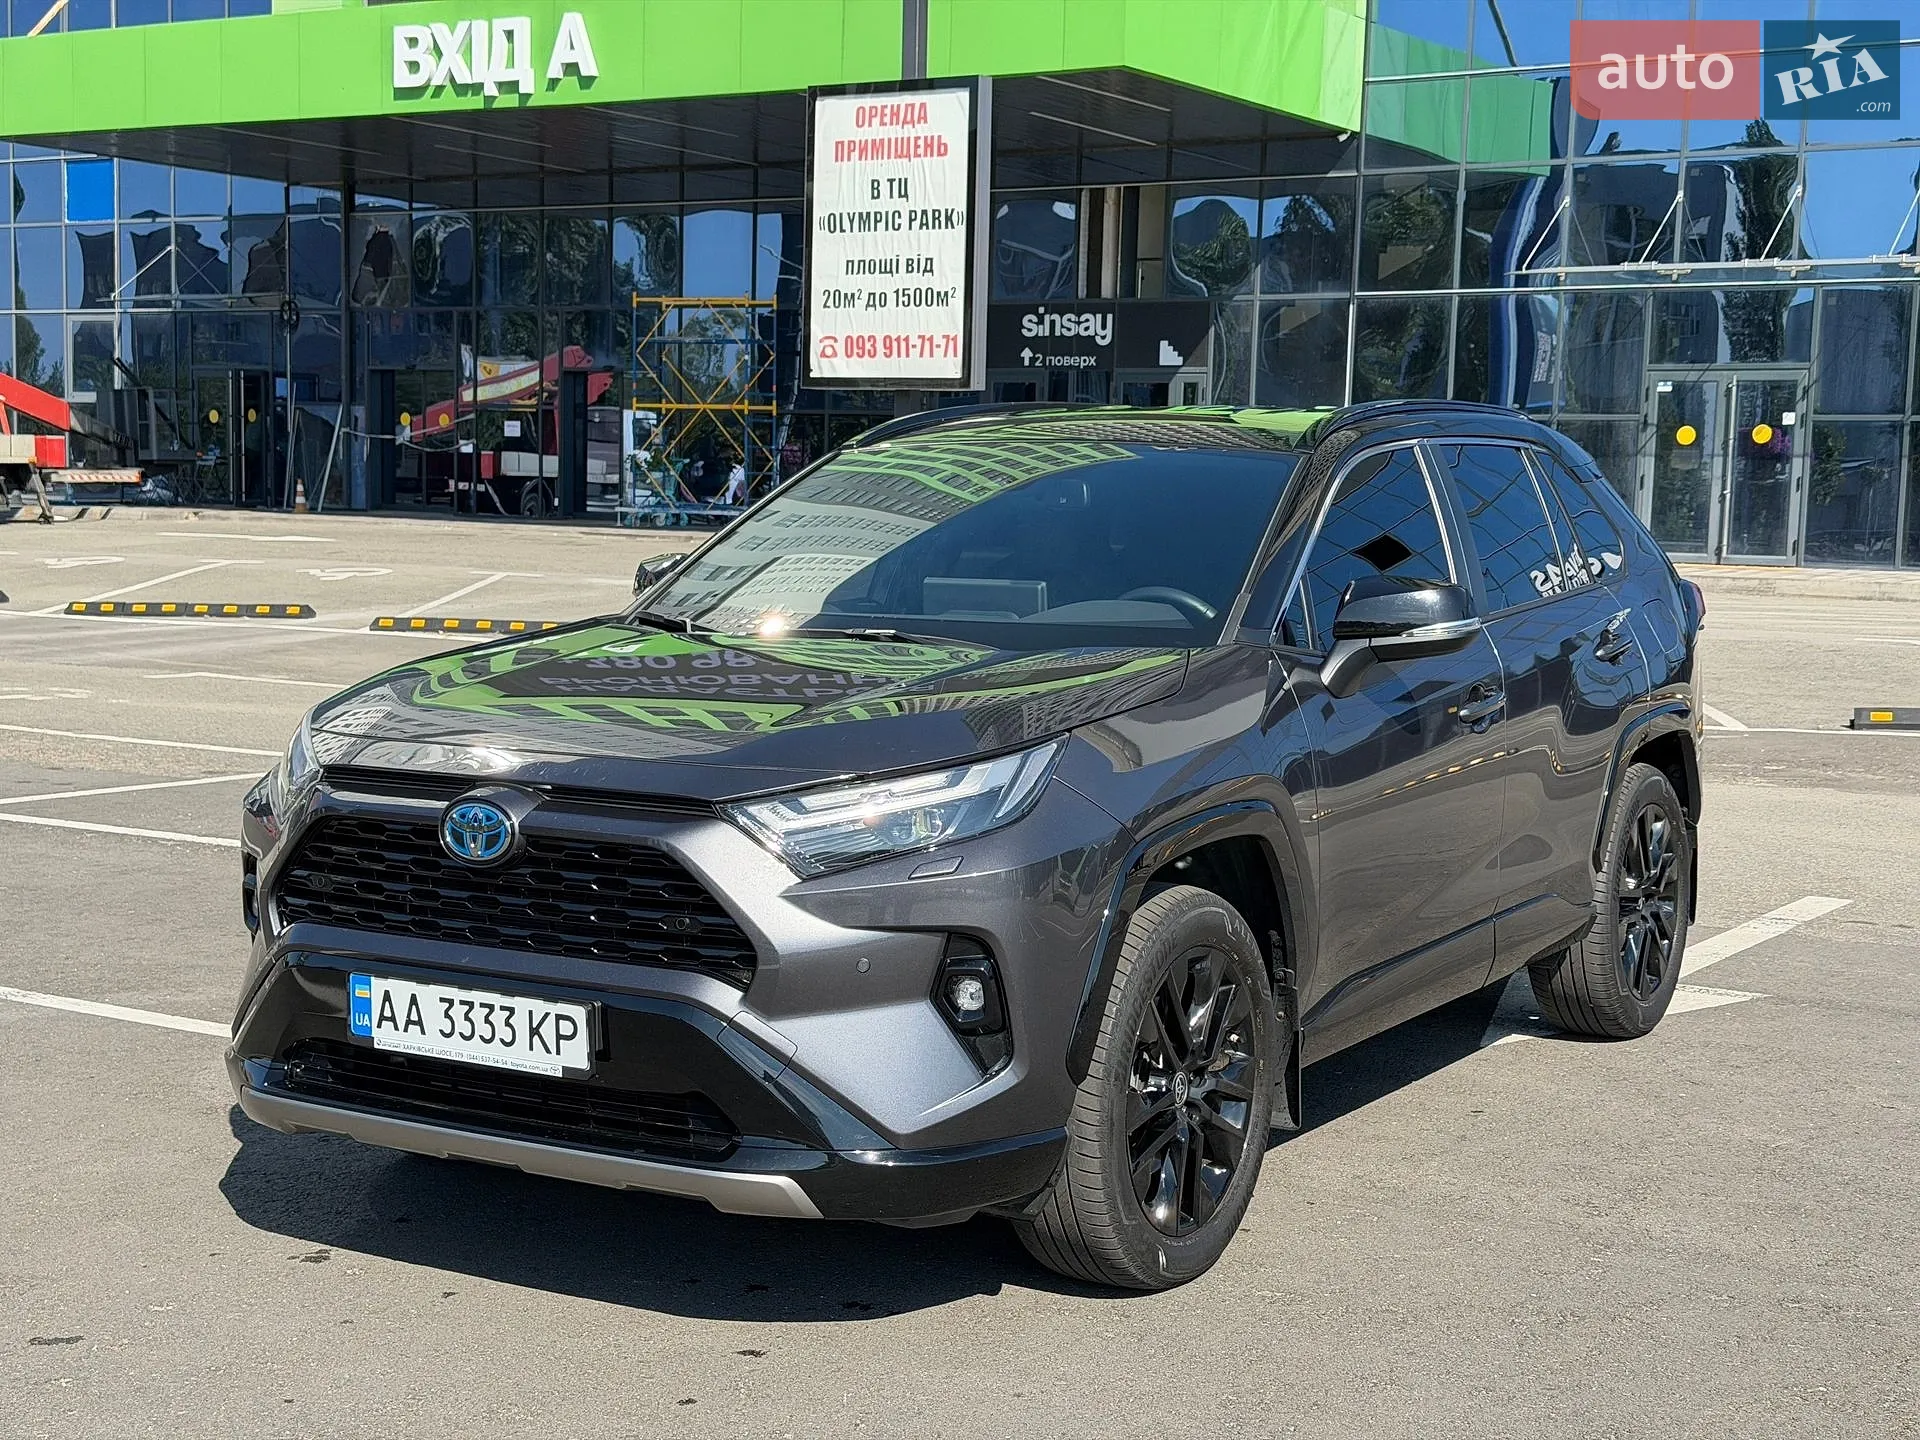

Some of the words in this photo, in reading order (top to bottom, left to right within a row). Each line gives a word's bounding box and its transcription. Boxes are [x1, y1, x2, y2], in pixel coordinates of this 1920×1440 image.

[393, 16, 535, 97] ВХІД
[546, 11, 600, 79] А
[855, 102, 929, 129] ОРЕНДА
[834, 134, 949, 163] ПРИМІЩЕНЬ
[870, 178, 881, 201] В
[886, 177, 909, 202] ТЦ
[818, 209, 902, 234] «OLYMPIC
[908, 207, 965, 230] PARK»
[845, 254, 901, 277] площі
[905, 253, 935, 277] від
[865, 291, 888, 312] до
[1021, 306, 1114, 346] sinsay
[844, 334, 877, 359] 093
[882, 333, 959, 359] 911-71-71
[1034, 353, 1043, 367] 2
[1046, 355, 1097, 369] поверх
[355, 1012, 371, 1027] UA
[376, 989, 427, 1035] AA
[438, 996, 517, 1048] 3333
[528, 1009, 579, 1056] KP
